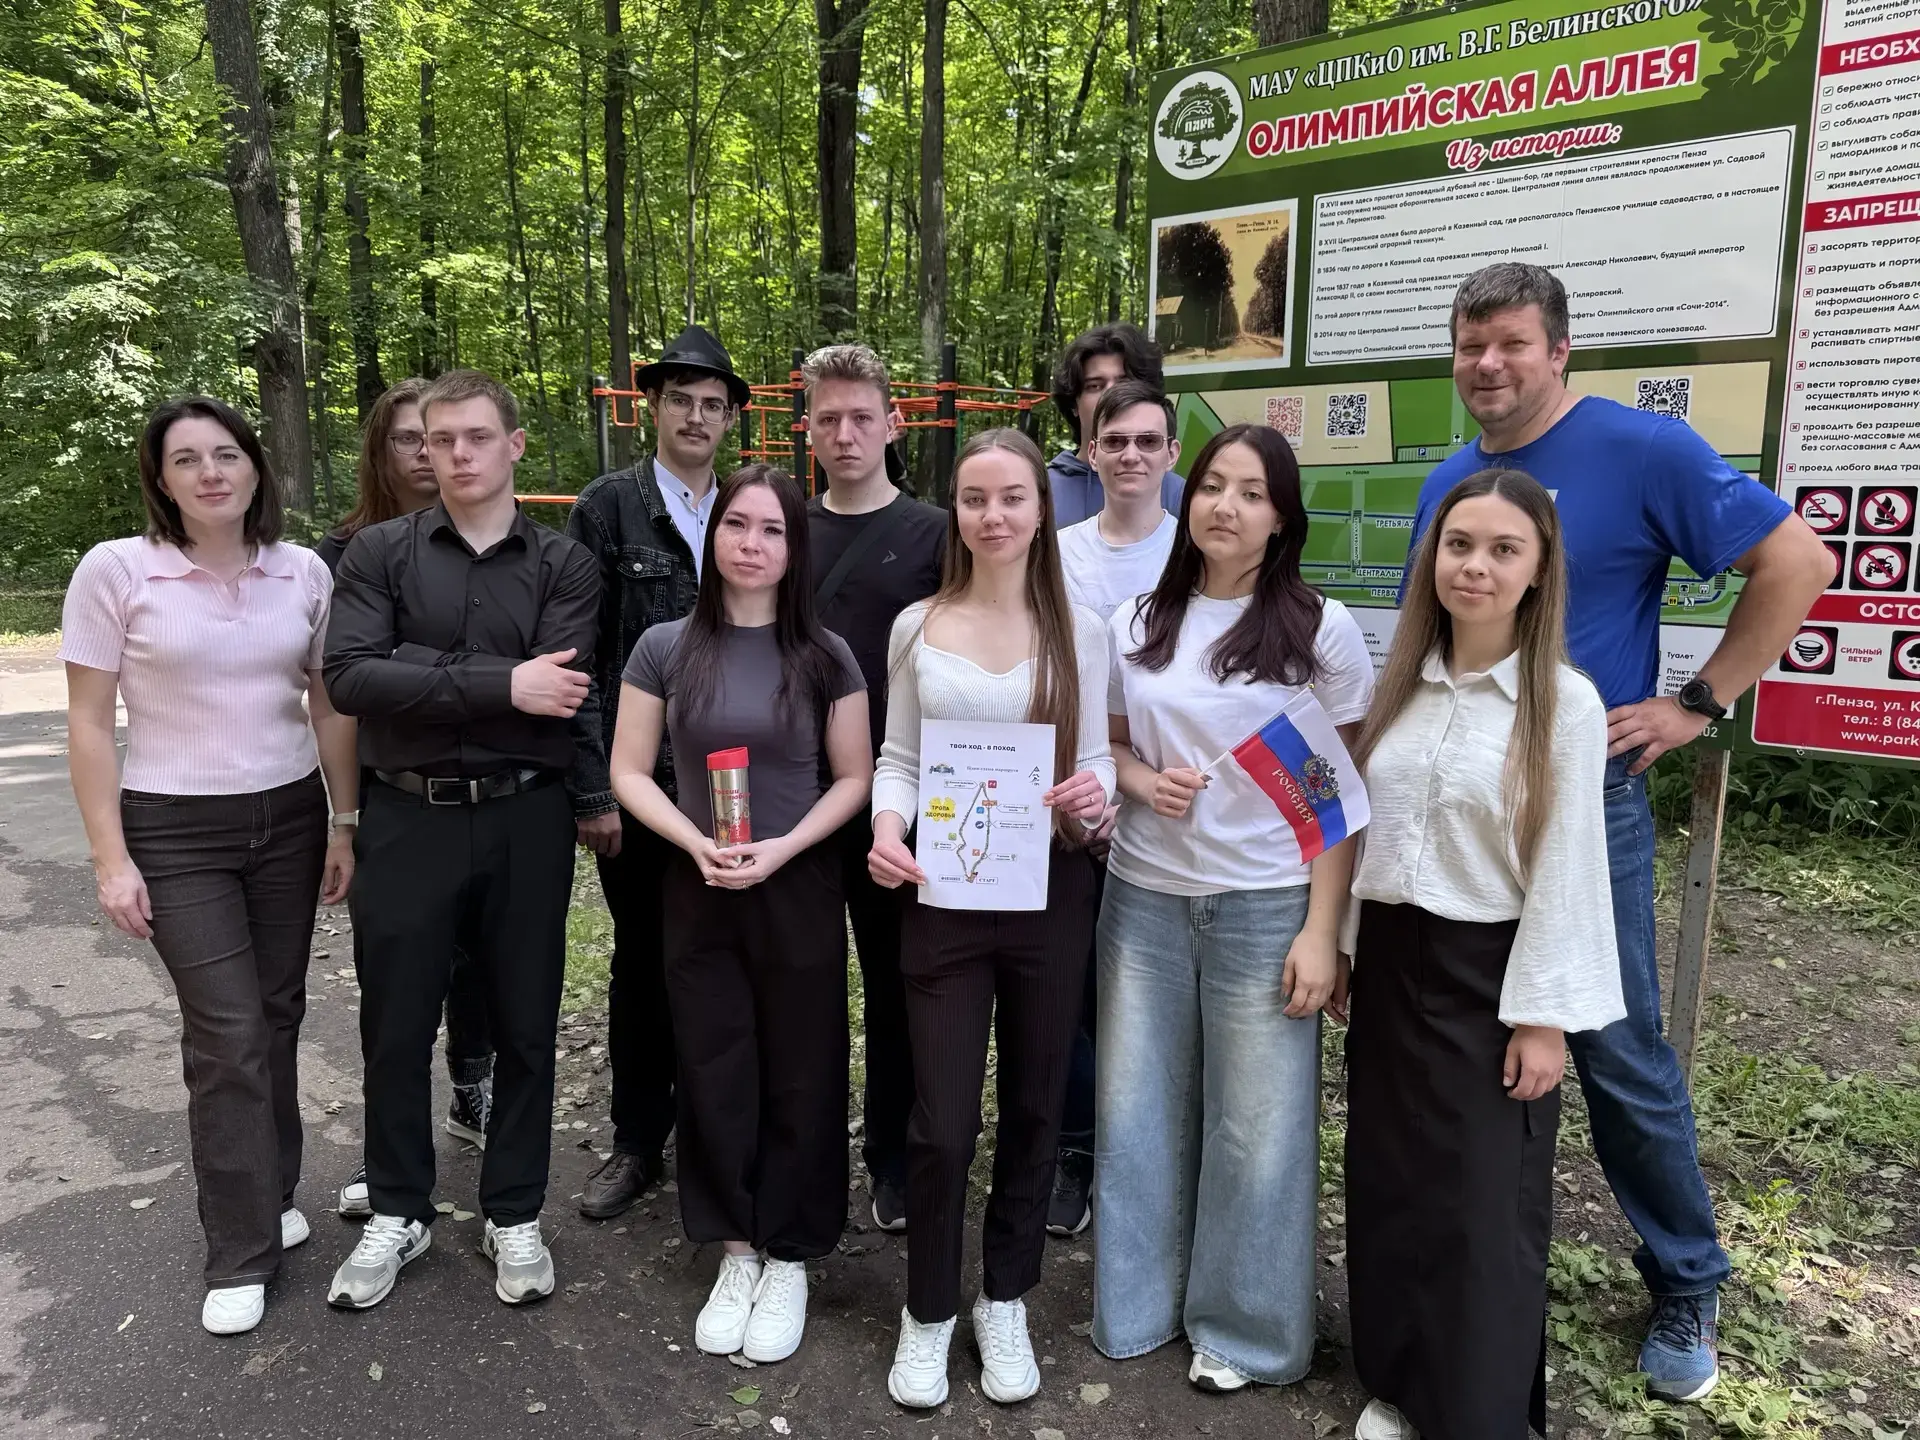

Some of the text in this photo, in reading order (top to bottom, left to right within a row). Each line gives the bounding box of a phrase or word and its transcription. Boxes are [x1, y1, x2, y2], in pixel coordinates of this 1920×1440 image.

[1844, 0, 1910, 16] выделенные
[1843, 8, 1920, 28] занятий спорт
[1248, 0, 1700, 100] МАУ «ЦПКиО им. В.Г. Белинского»
[1840, 37, 1920, 67] НЕОБХ
[1836, 74, 1920, 93] бережно относи
[1249, 72, 1536, 156] ОЛИМПИЙСКАЯ
[1546, 42, 1699, 101] АЛЛЕЯ
[1834, 92, 1920, 110] соблюдать чист
[1832, 114, 1889, 127] соблюдать
[1448, 122, 1623, 169] Из истории:
[1831, 134, 1887, 147] выгуливать
[1829, 144, 1898, 159] намордников
[1827, 166, 1883, 180] при выгуле
[1826, 173, 1920, 190] жизнедеятельност
[1823, 197, 1920, 224] ЗАПРЕЩ
[1820, 235, 1920, 251] засорять территор
[1565, 259, 1607, 268] Александр
[1608, 254, 1658, 263] Николаевич,
[1660, 248, 1696, 259] будущий
[1698, 245, 1745, 255] император
[1817, 261, 1876, 274] разрушать
[1572, 287, 1624, 298] Гиляровский.
[1815, 284, 1876, 296] размещать
[1815, 293, 1910, 306] информационного
[1596, 307, 1654, 317] Олимпийского
[1814, 308, 1832, 316] без
[1832, 304, 1895, 317] разрешения
[1571, 325, 1706, 341] рысаков пензенского конезавода.
[1812, 324, 1920, 339] устанавливать манг
[1427, 340, 1452, 349] просле
[1810, 337, 1866, 349] распивать
[1808, 358, 1880, 367] использовать
[1838, 379, 1889, 388] торговлю
[1805, 390, 1879, 401] осуществлять
[1881, 389, 1910, 398] иную
[1802, 421, 1872, 432] проводить без
[1801, 431, 1905, 442] зрелищно-массовые
[1800, 443, 1887, 451] без согласования
[1834, 462, 1871, 471] любого
[1375, 520, 1402, 528] ТРЕТЬЯ
[1371, 589, 1399, 597] ПЕРВА
[1860, 602, 1920, 620] ОСТО
[1667, 652, 1694, 660] Туалет
[1840, 647, 1883, 656] СИЛЬНЫЙ
[1666, 668, 1690, 676] Пункт
[1815, 694, 1877, 710] г.Пенза,
[1883, 701, 1905, 712] ул.
[1843, 714, 1920, 729] тел.: 8 (84
[1841, 731, 1920, 746] www.park
[1272, 768, 1314, 824] РОССИЯ
